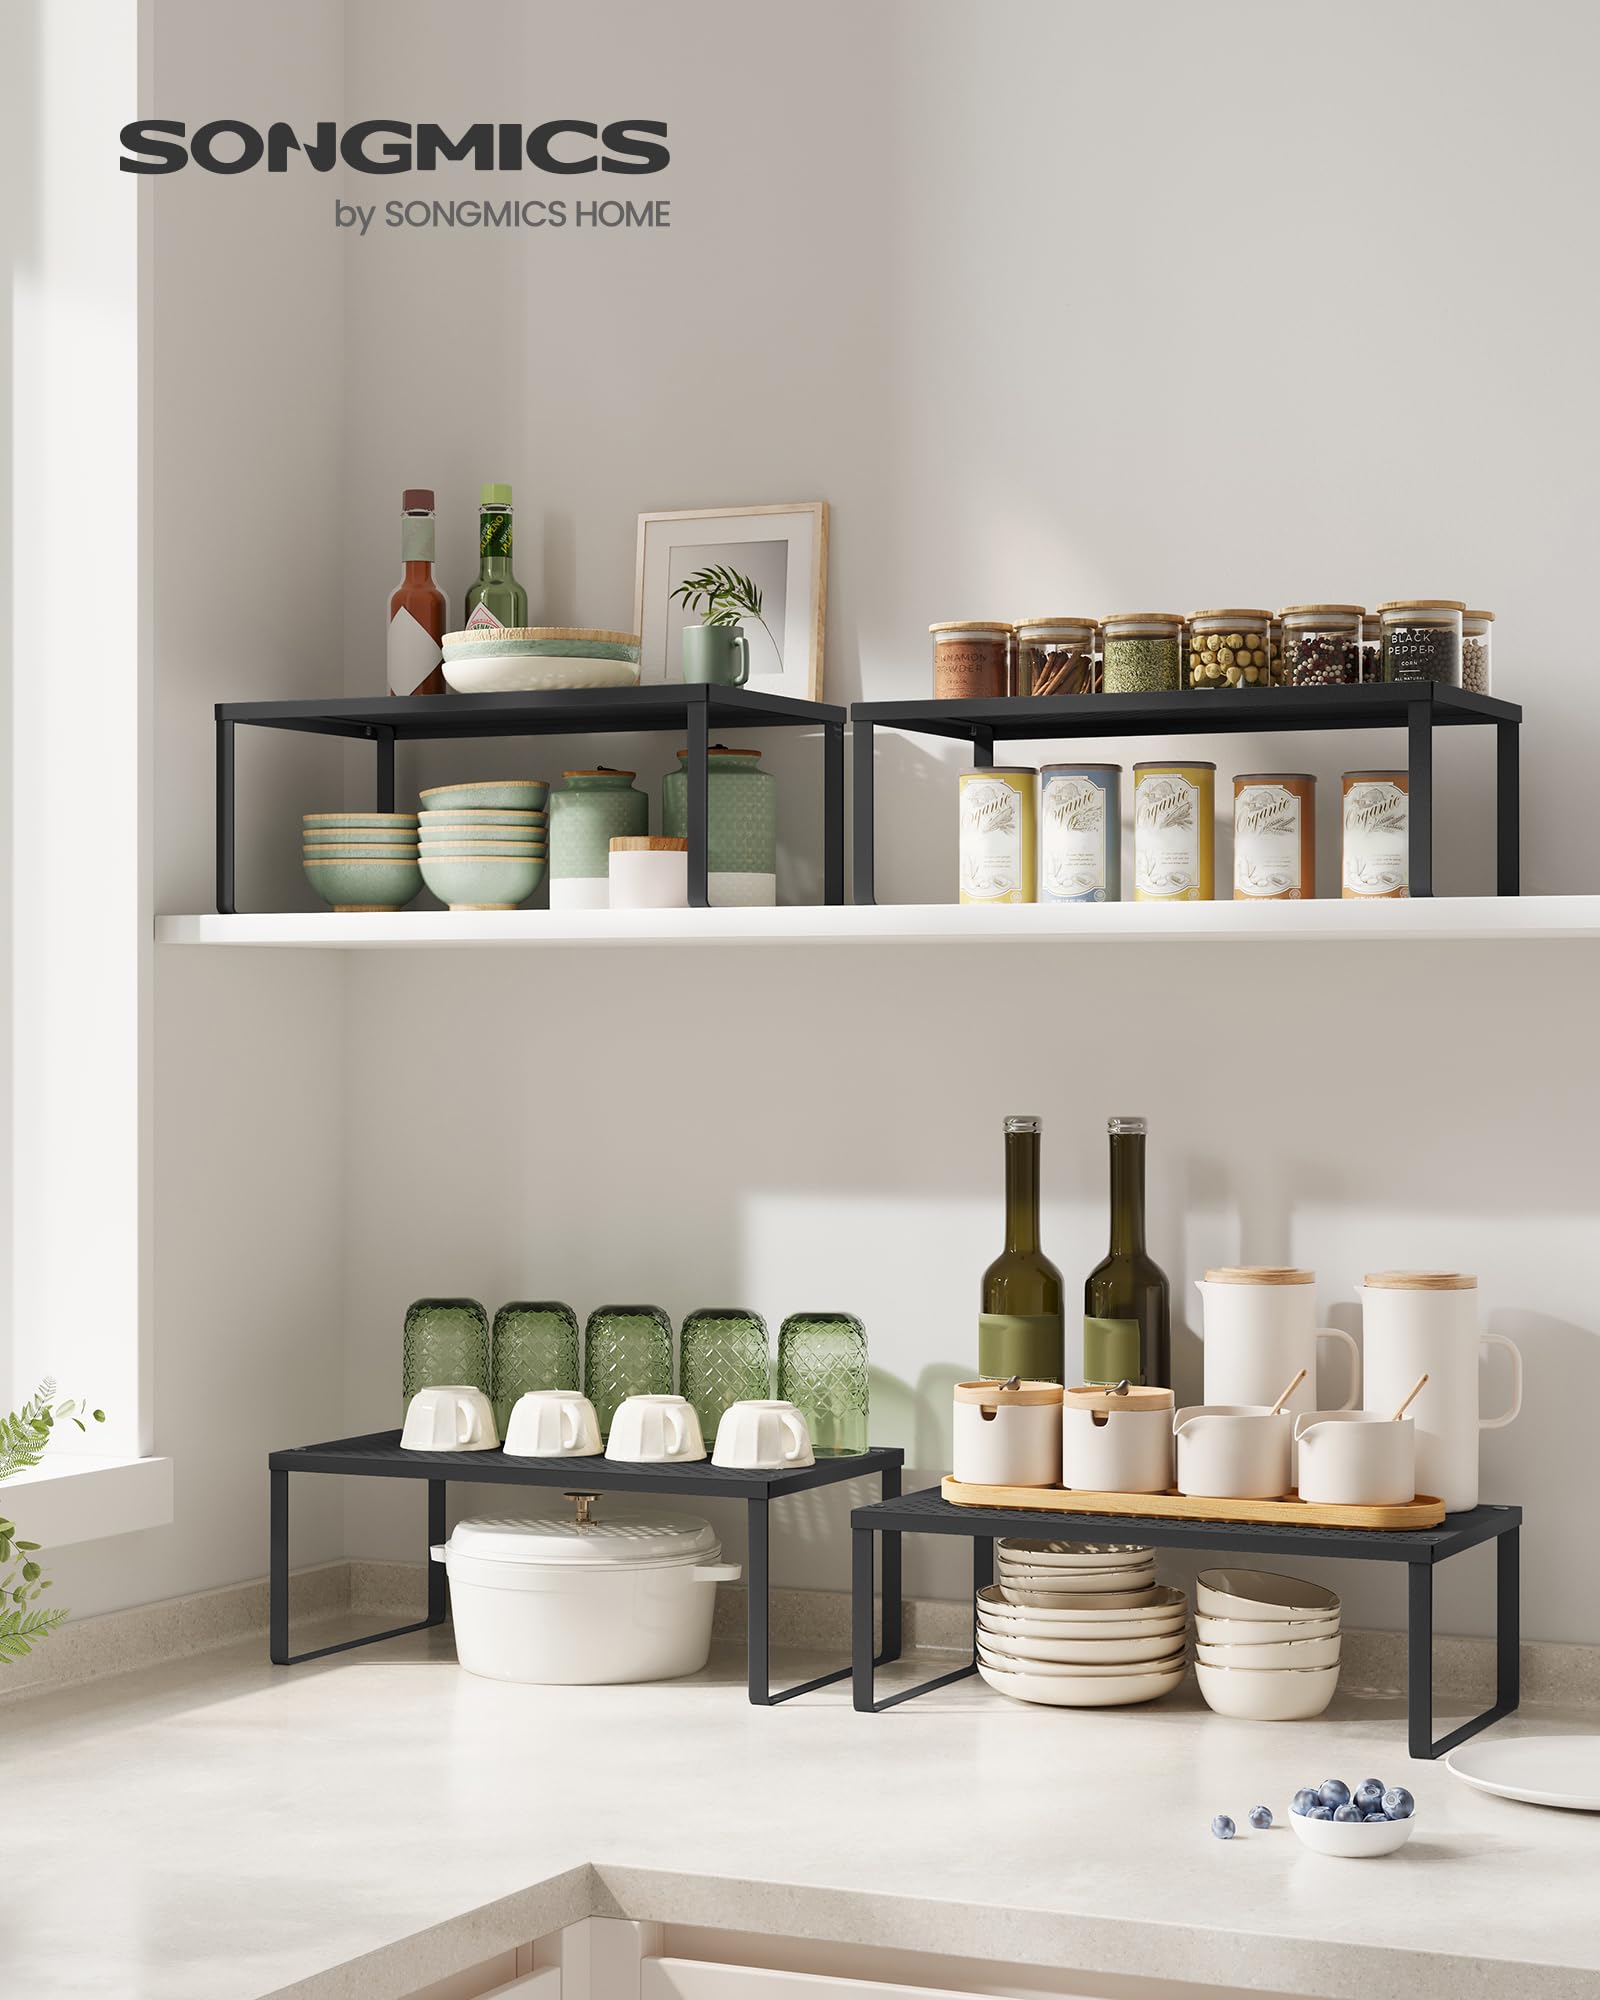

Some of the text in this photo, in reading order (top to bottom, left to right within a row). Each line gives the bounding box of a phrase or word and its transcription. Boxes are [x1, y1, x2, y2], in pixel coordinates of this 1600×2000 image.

[1391, 633, 1431, 644] BLACK
[1388, 645, 1435, 656] PEPPER
[1237, 797, 1290, 832] Organic
[1345, 794, 1401, 831] Organic
